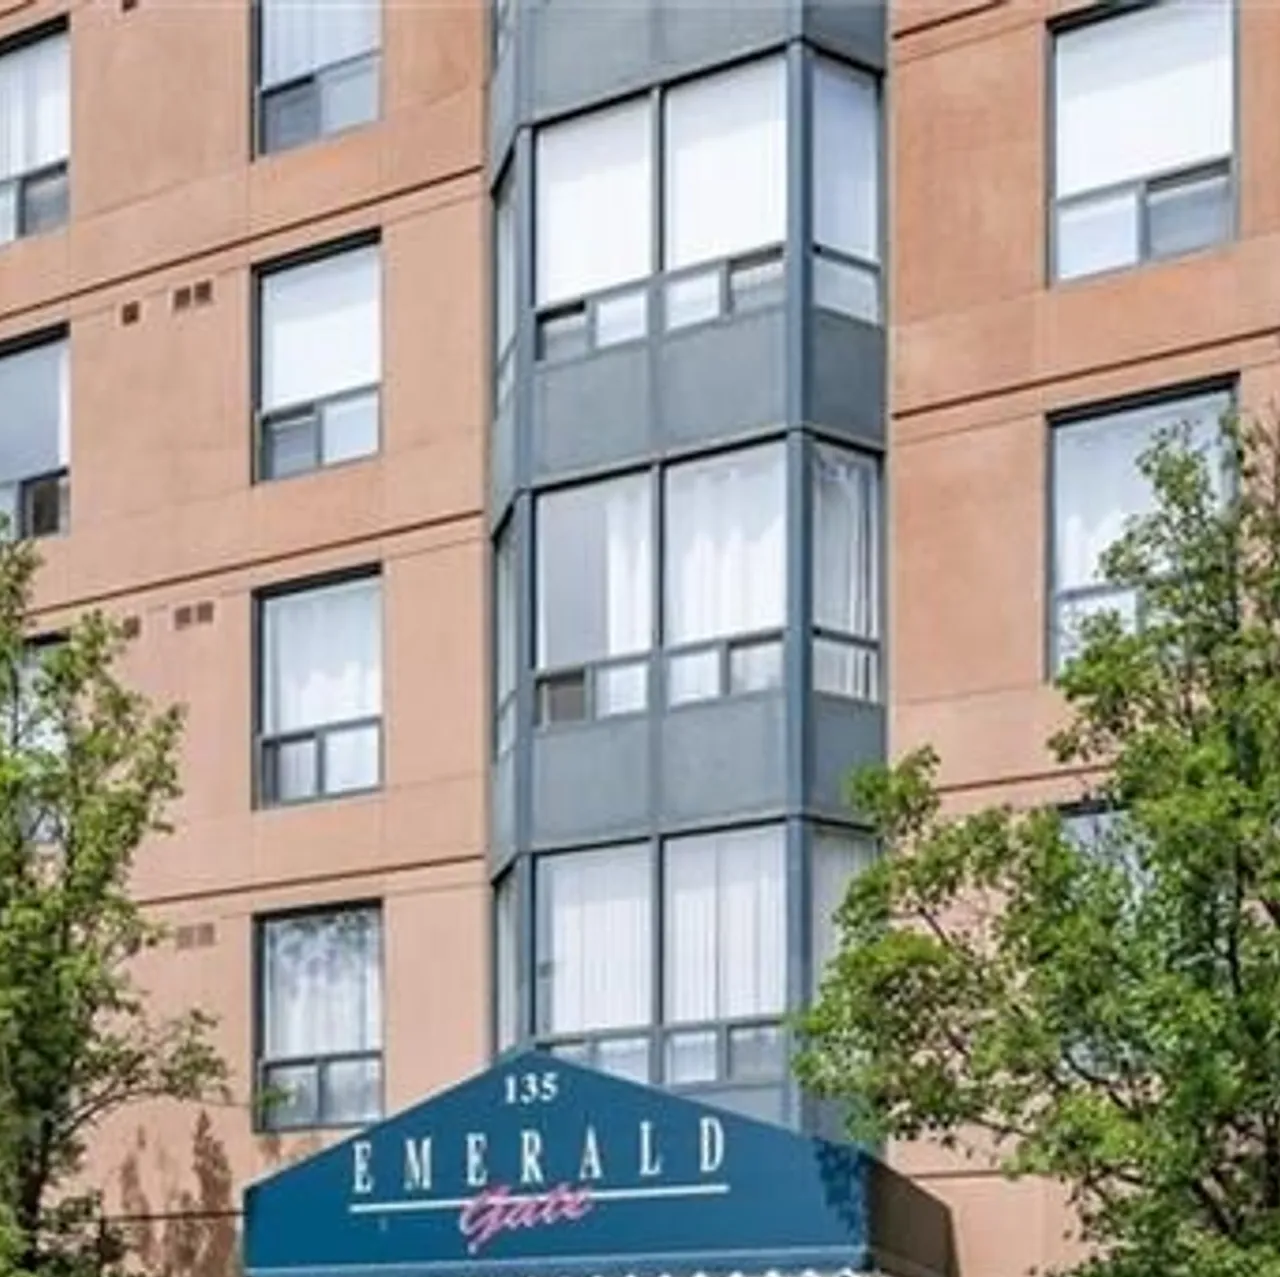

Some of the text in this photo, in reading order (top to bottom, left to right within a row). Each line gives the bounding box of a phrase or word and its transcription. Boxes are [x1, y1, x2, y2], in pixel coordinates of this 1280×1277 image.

[504, 1072, 558, 1104] 135
[353, 1117, 725, 1193] EMERALD
[459, 1182, 594, 1254] Gate
